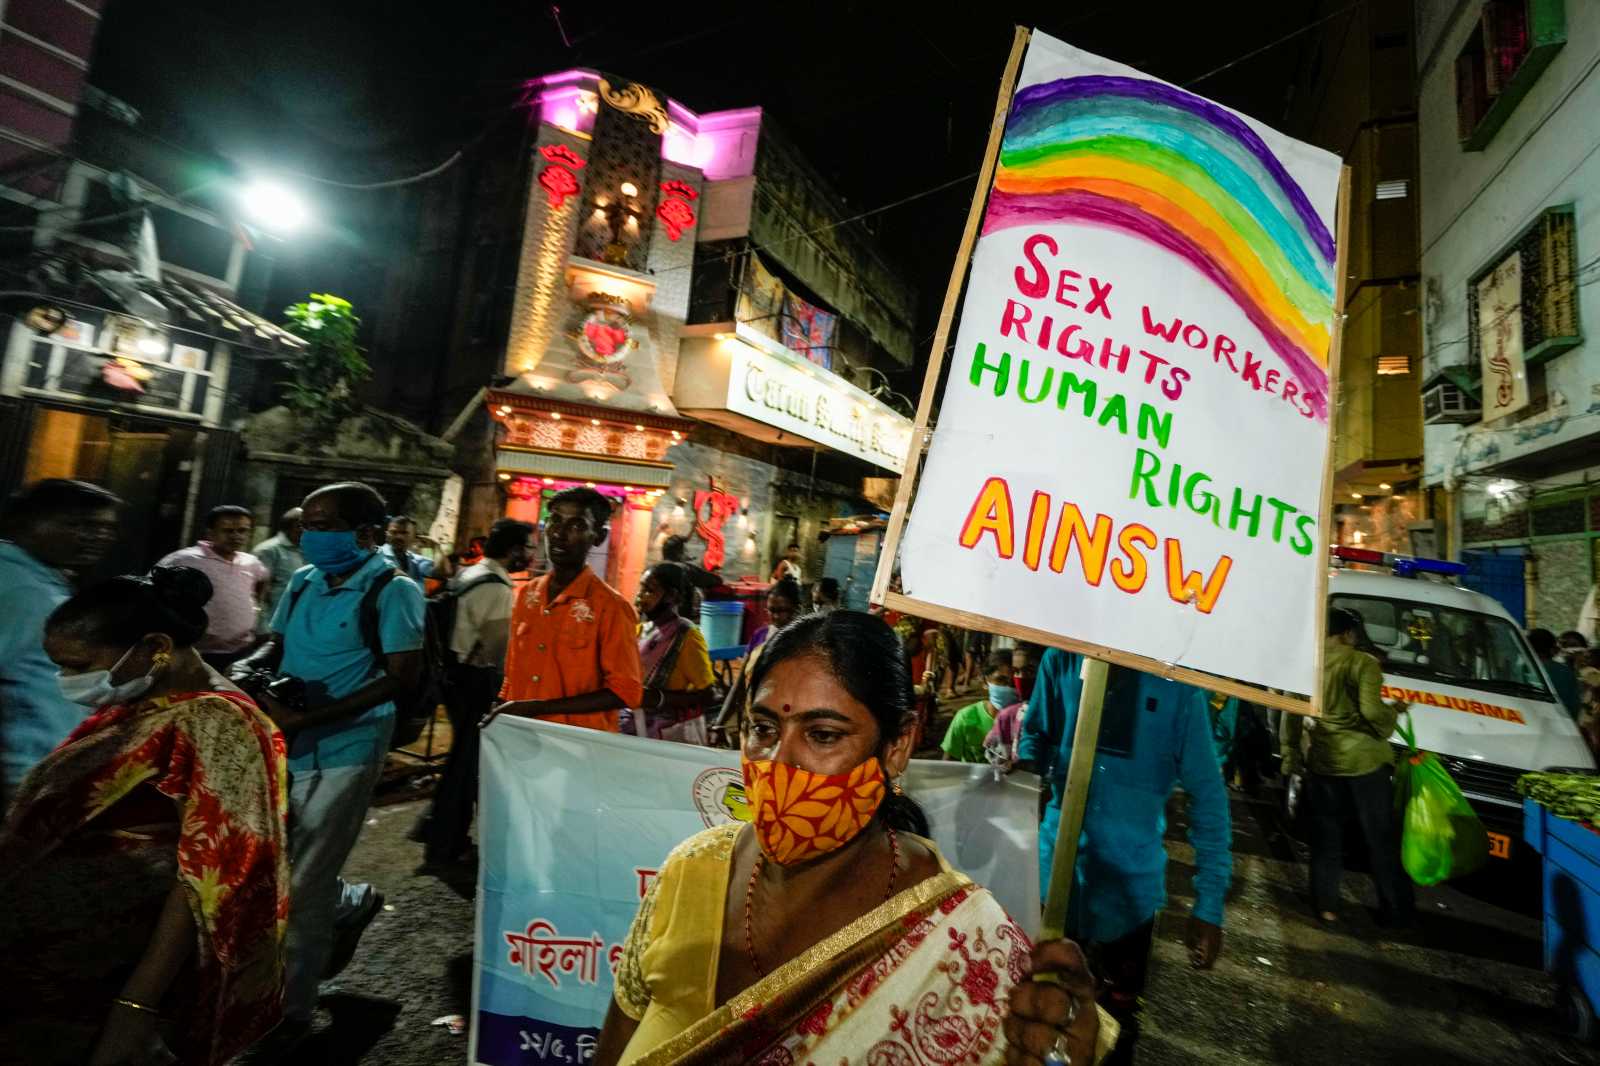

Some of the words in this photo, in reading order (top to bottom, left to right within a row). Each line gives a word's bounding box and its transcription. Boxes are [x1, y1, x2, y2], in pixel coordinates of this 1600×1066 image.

[999, 298, 1192, 401] RIGHTS
[1014, 233, 1113, 320] SEX
[1141, 305, 1317, 419] WORKERS
[968, 341, 1173, 449] HUMAN
[958, 476, 1233, 614] AINSW
[1129, 447, 1316, 556] RIGHTS
[505, 920, 604, 988] মহিলা
